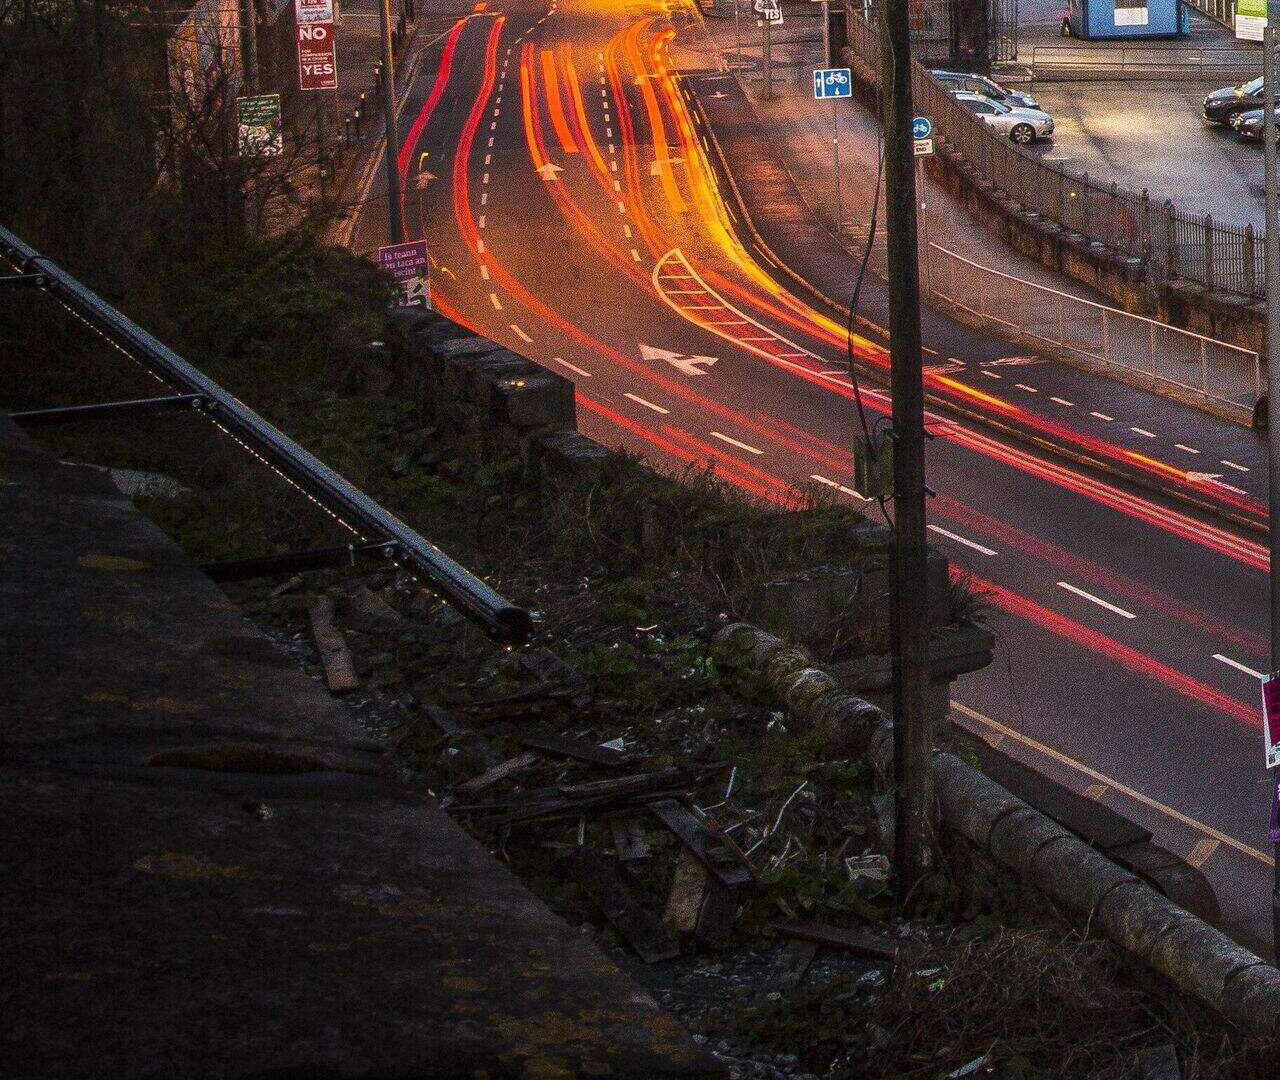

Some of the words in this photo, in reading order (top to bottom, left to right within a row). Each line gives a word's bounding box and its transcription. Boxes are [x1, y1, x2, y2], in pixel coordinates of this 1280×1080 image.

[764, 9, 780, 20] YES
[300, 27, 327, 40] NO
[302, 63, 334, 75] YES
